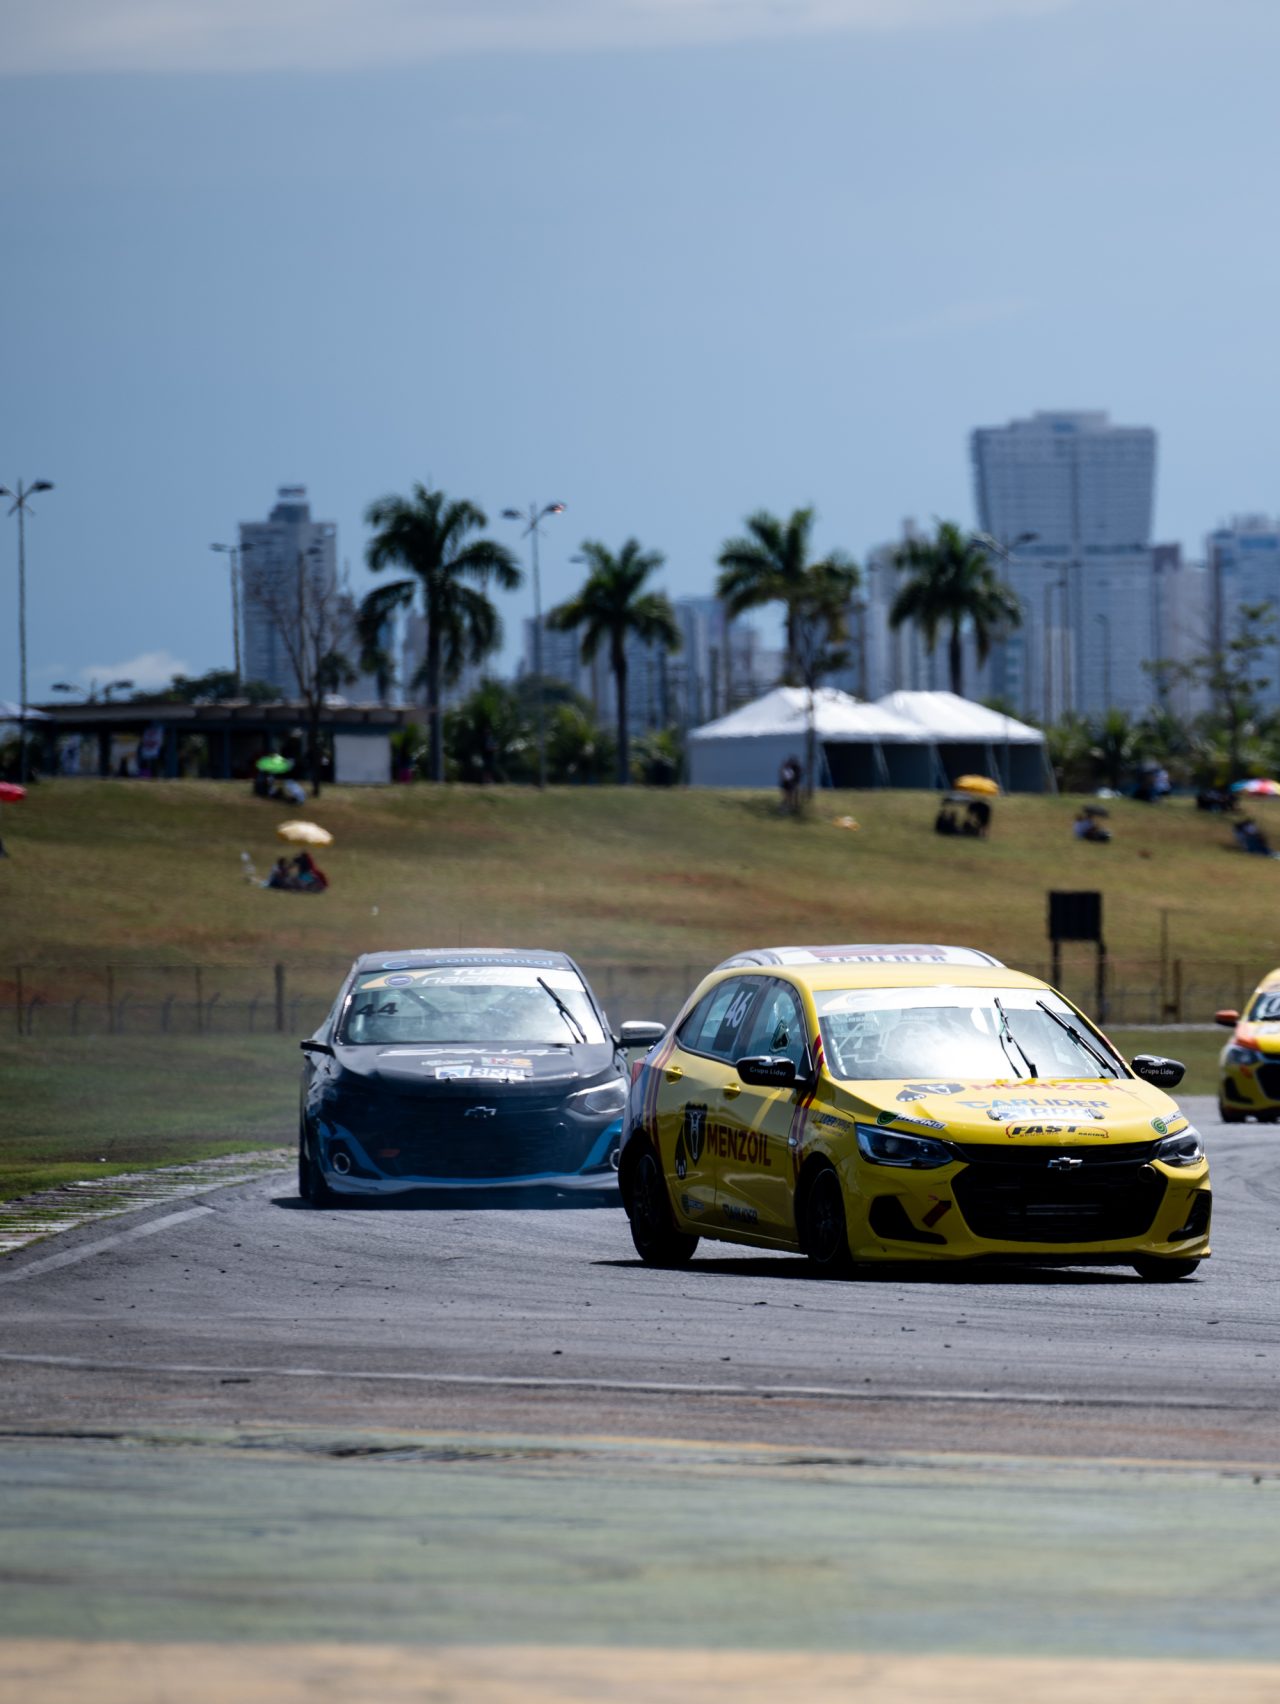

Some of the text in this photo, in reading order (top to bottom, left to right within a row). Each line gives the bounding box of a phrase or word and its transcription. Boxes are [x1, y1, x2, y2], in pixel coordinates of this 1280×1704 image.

[434, 957, 553, 966] continental
[356, 1001, 398, 1016] 44
[725, 991, 753, 1028] 46
[750, 1065, 768, 1076] Grupo
[1140, 1067, 1159, 1076] Grupo
[1012, 1125, 1077, 1135] FAST
[706, 1123, 772, 1166] MENZOIL
